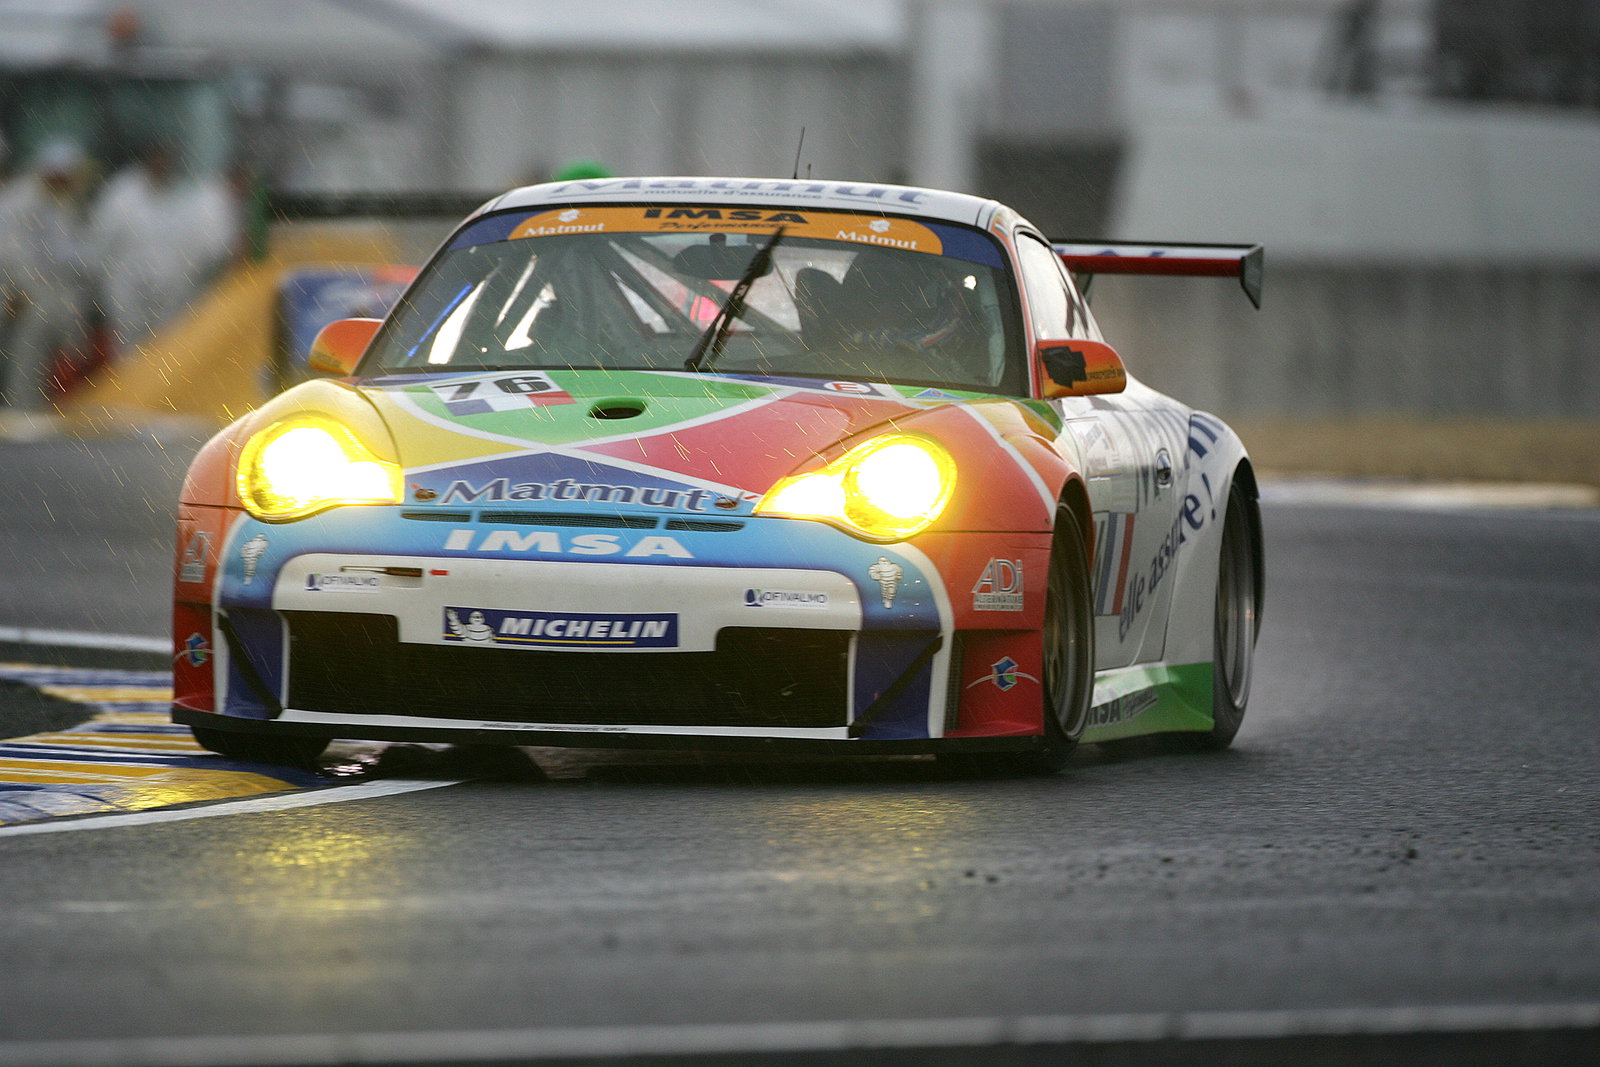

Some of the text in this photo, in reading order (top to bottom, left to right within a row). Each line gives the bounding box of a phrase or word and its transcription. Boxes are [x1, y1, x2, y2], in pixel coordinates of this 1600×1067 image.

[643, 188, 822, 200] mutuelle d'assurance
[643, 208, 809, 225] IMSA
[522, 222, 606, 237] Matmut
[835, 229, 919, 250] Matmut
[431, 376, 552, 401] 76
[438, 478, 713, 513] Matmut
[443, 529, 696, 560] IMSA
[500, 617, 669, 638] MICHELIN
